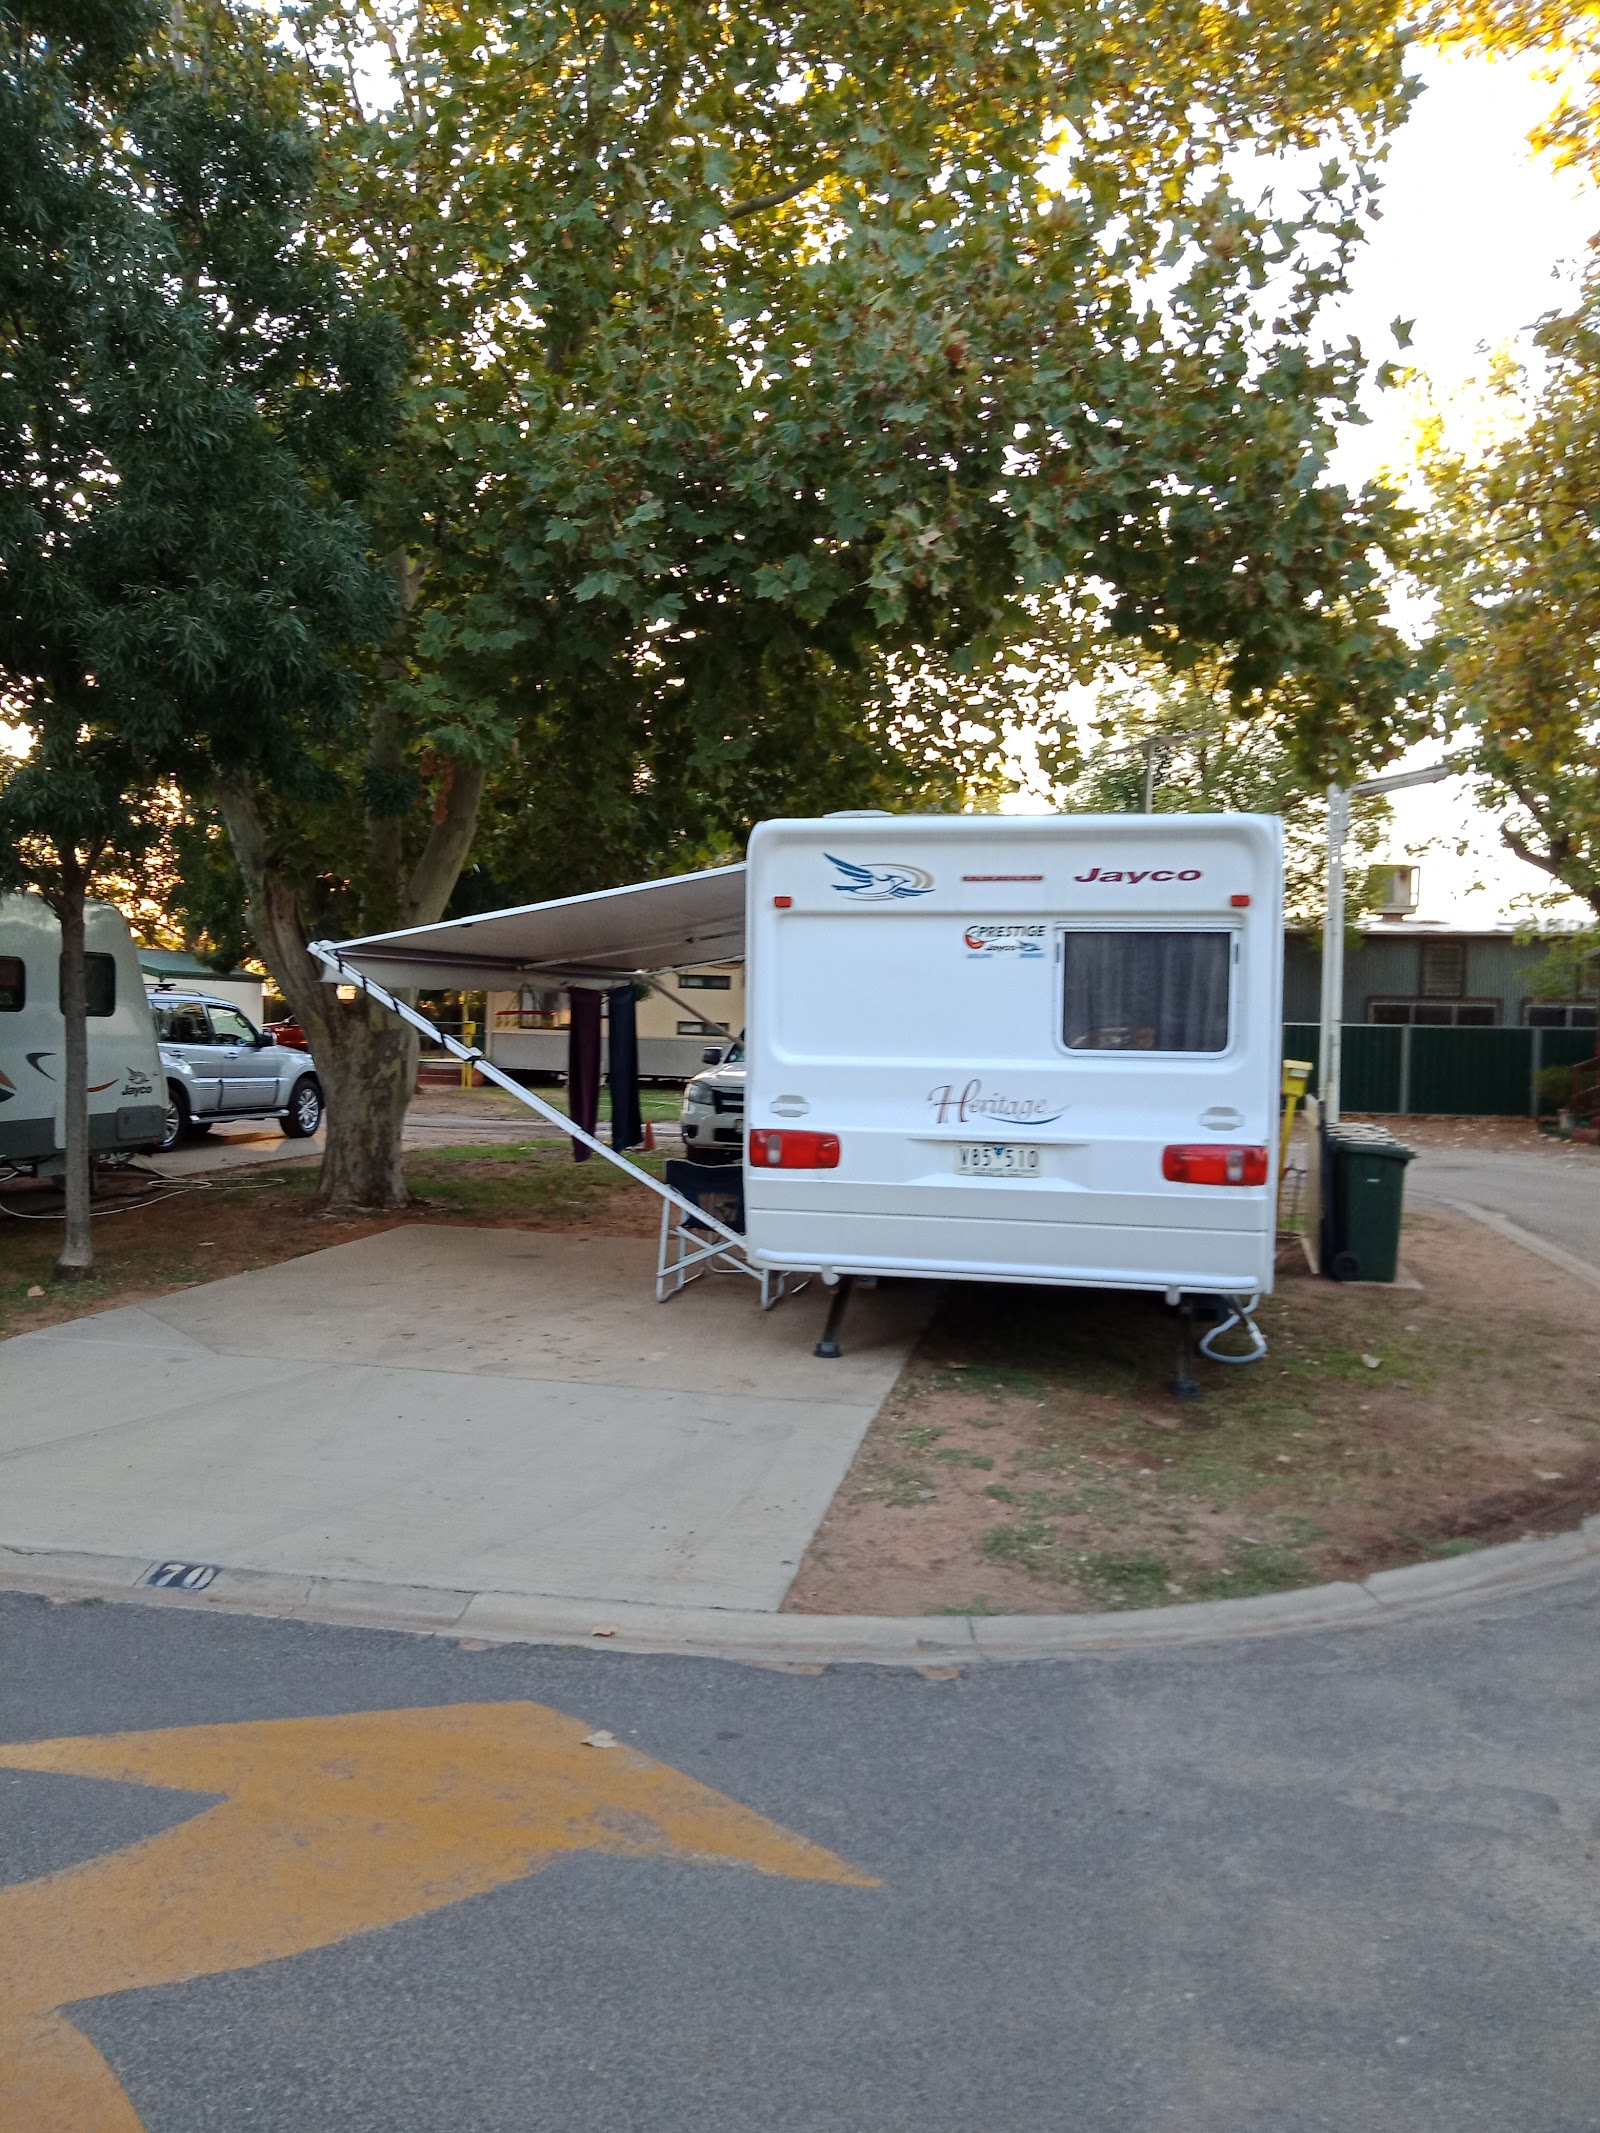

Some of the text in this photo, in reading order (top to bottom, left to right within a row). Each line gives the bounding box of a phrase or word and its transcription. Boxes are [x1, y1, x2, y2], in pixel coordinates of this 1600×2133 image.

[1074, 867, 1202, 884] Jayco
[978, 925, 1046, 937] PRESTIGE
[121, 1085, 153, 1097] Jayco
[927, 1078, 1048, 1124] Heritage
[155, 1563, 216, 1590] 70
